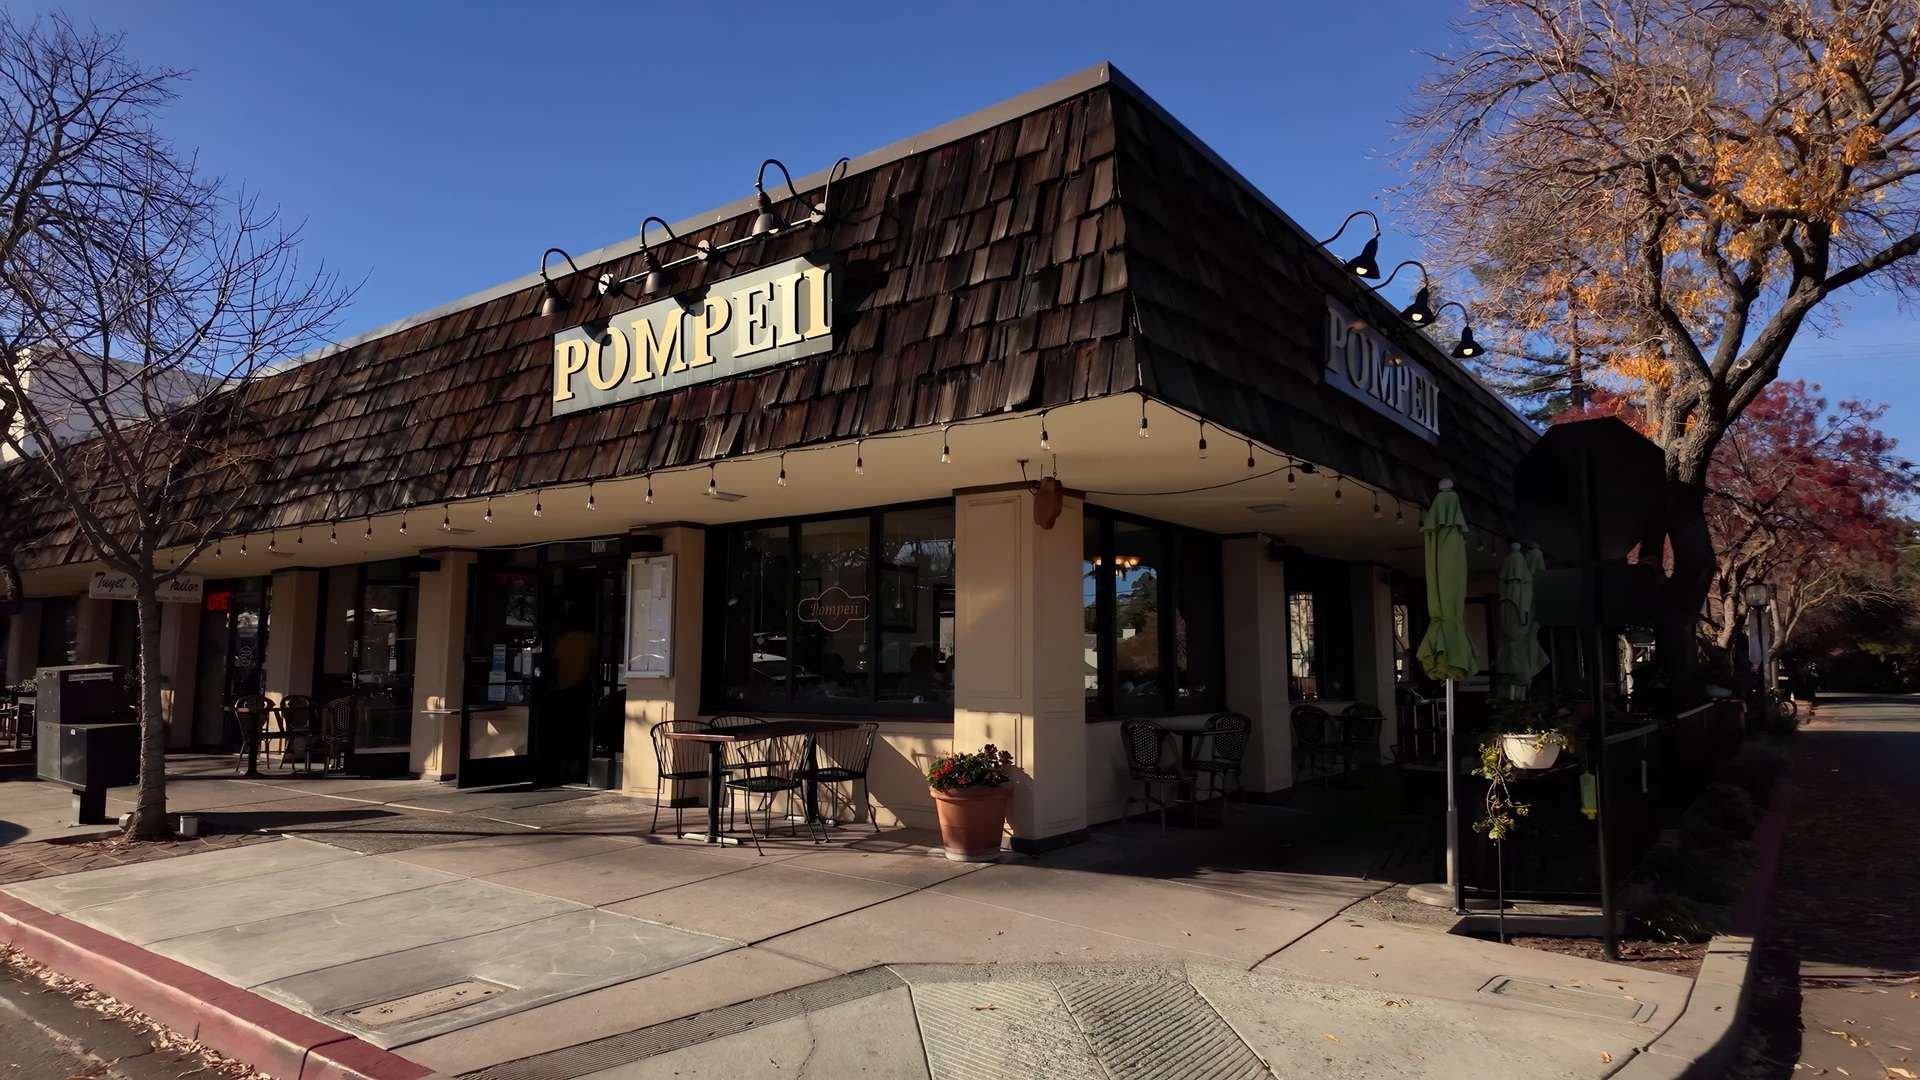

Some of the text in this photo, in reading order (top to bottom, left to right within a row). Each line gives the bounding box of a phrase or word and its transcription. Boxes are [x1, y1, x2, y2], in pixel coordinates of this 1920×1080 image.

[555, 264, 833, 402] POMPEII
[1327, 306, 1440, 436] POMPEII
[811, 602, 859, 617] Pompeii
